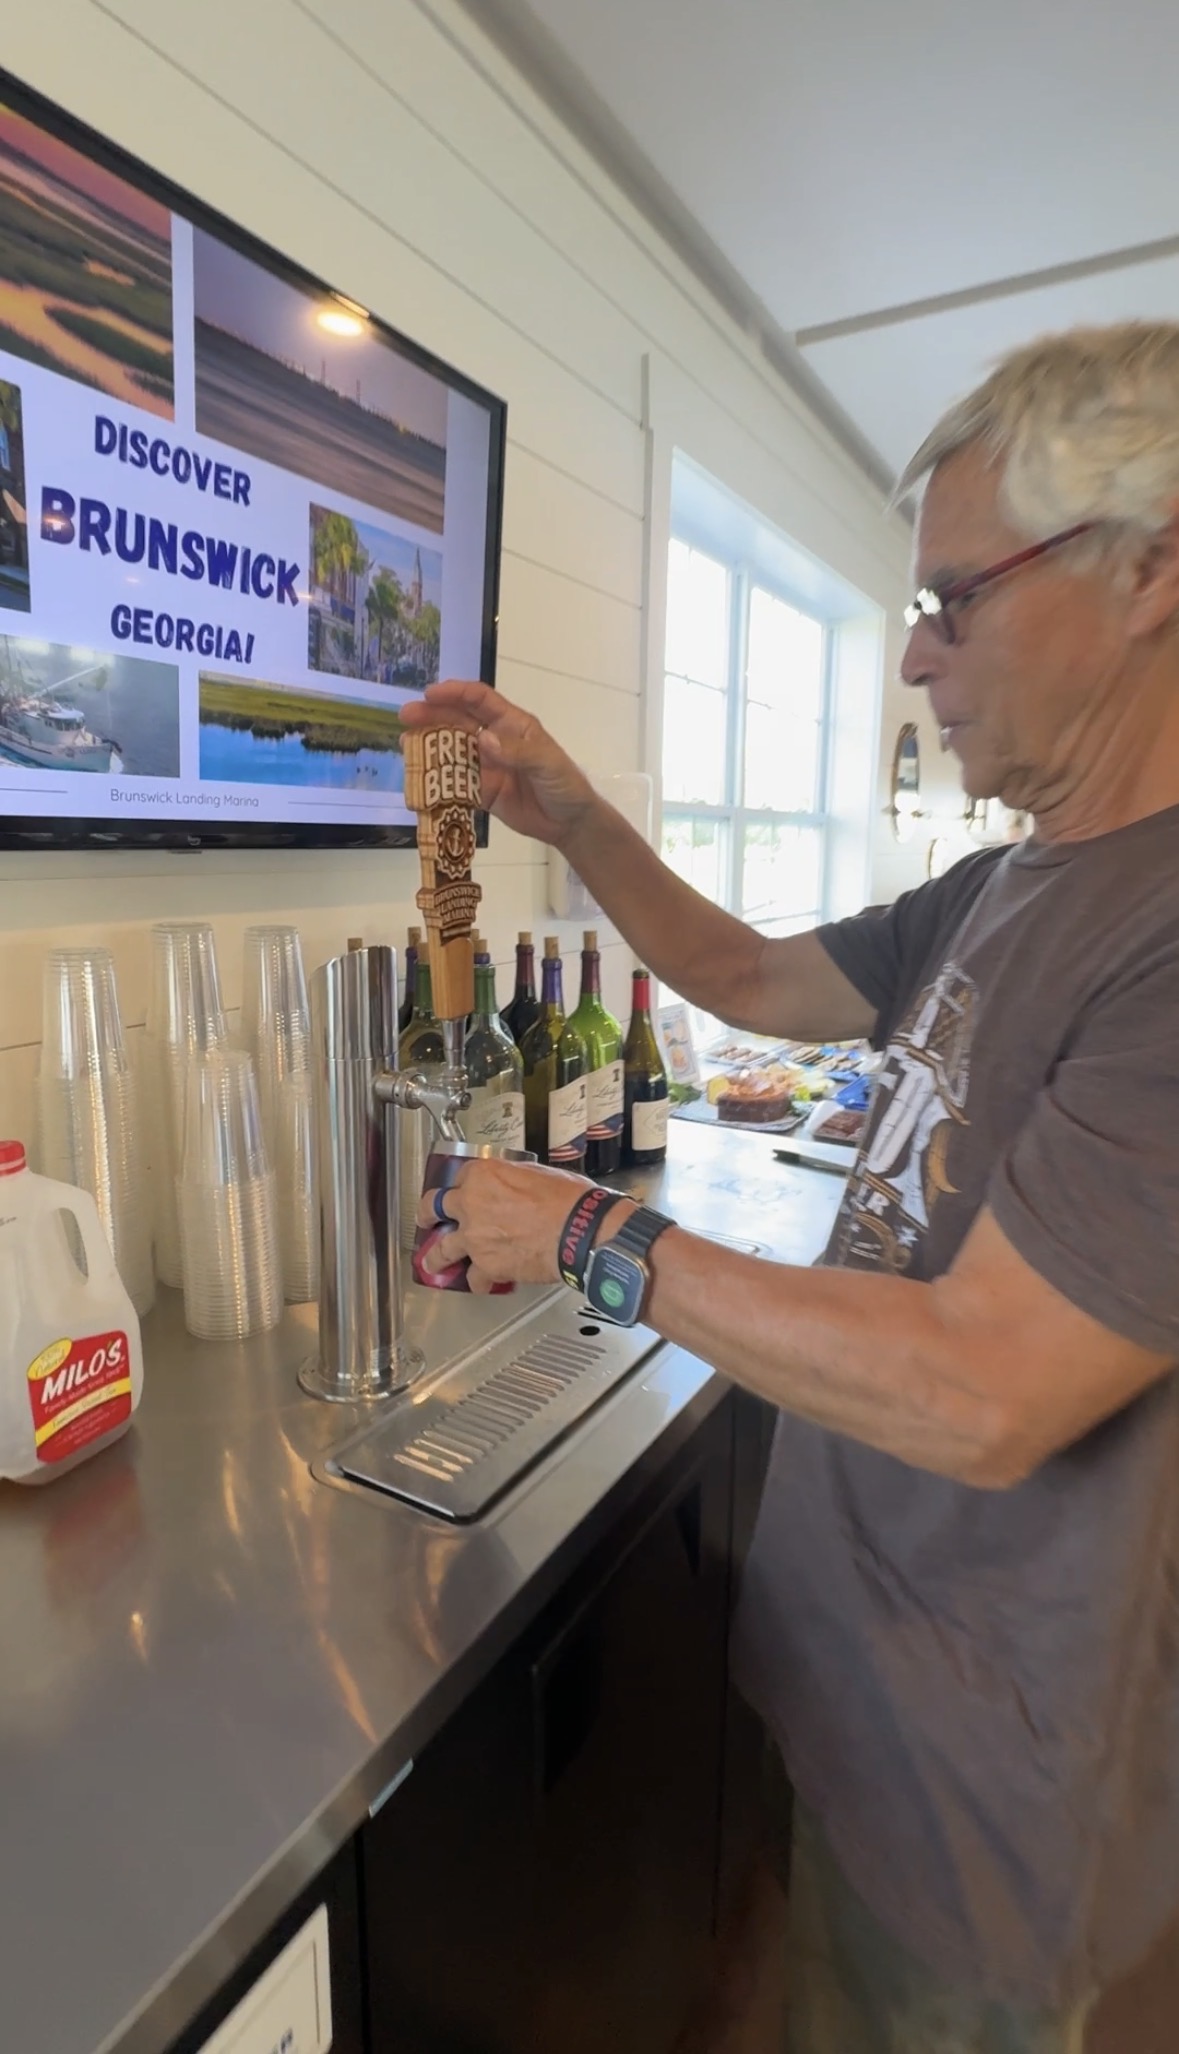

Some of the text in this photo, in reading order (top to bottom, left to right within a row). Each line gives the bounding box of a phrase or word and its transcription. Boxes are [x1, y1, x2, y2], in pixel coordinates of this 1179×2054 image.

[95, 415, 251, 507] DISCOVER
[40, 485, 300, 607] BRUNSWICK
[110, 603, 255, 665] GEORGIA!
[424, 730, 479, 770] FREE
[110, 788, 259, 808] Brunswick Landing Marina
[424, 765, 482, 807] BEER
[562, 1189, 608, 1266] ositive
[41, 1338, 122, 1405] MILO'S
